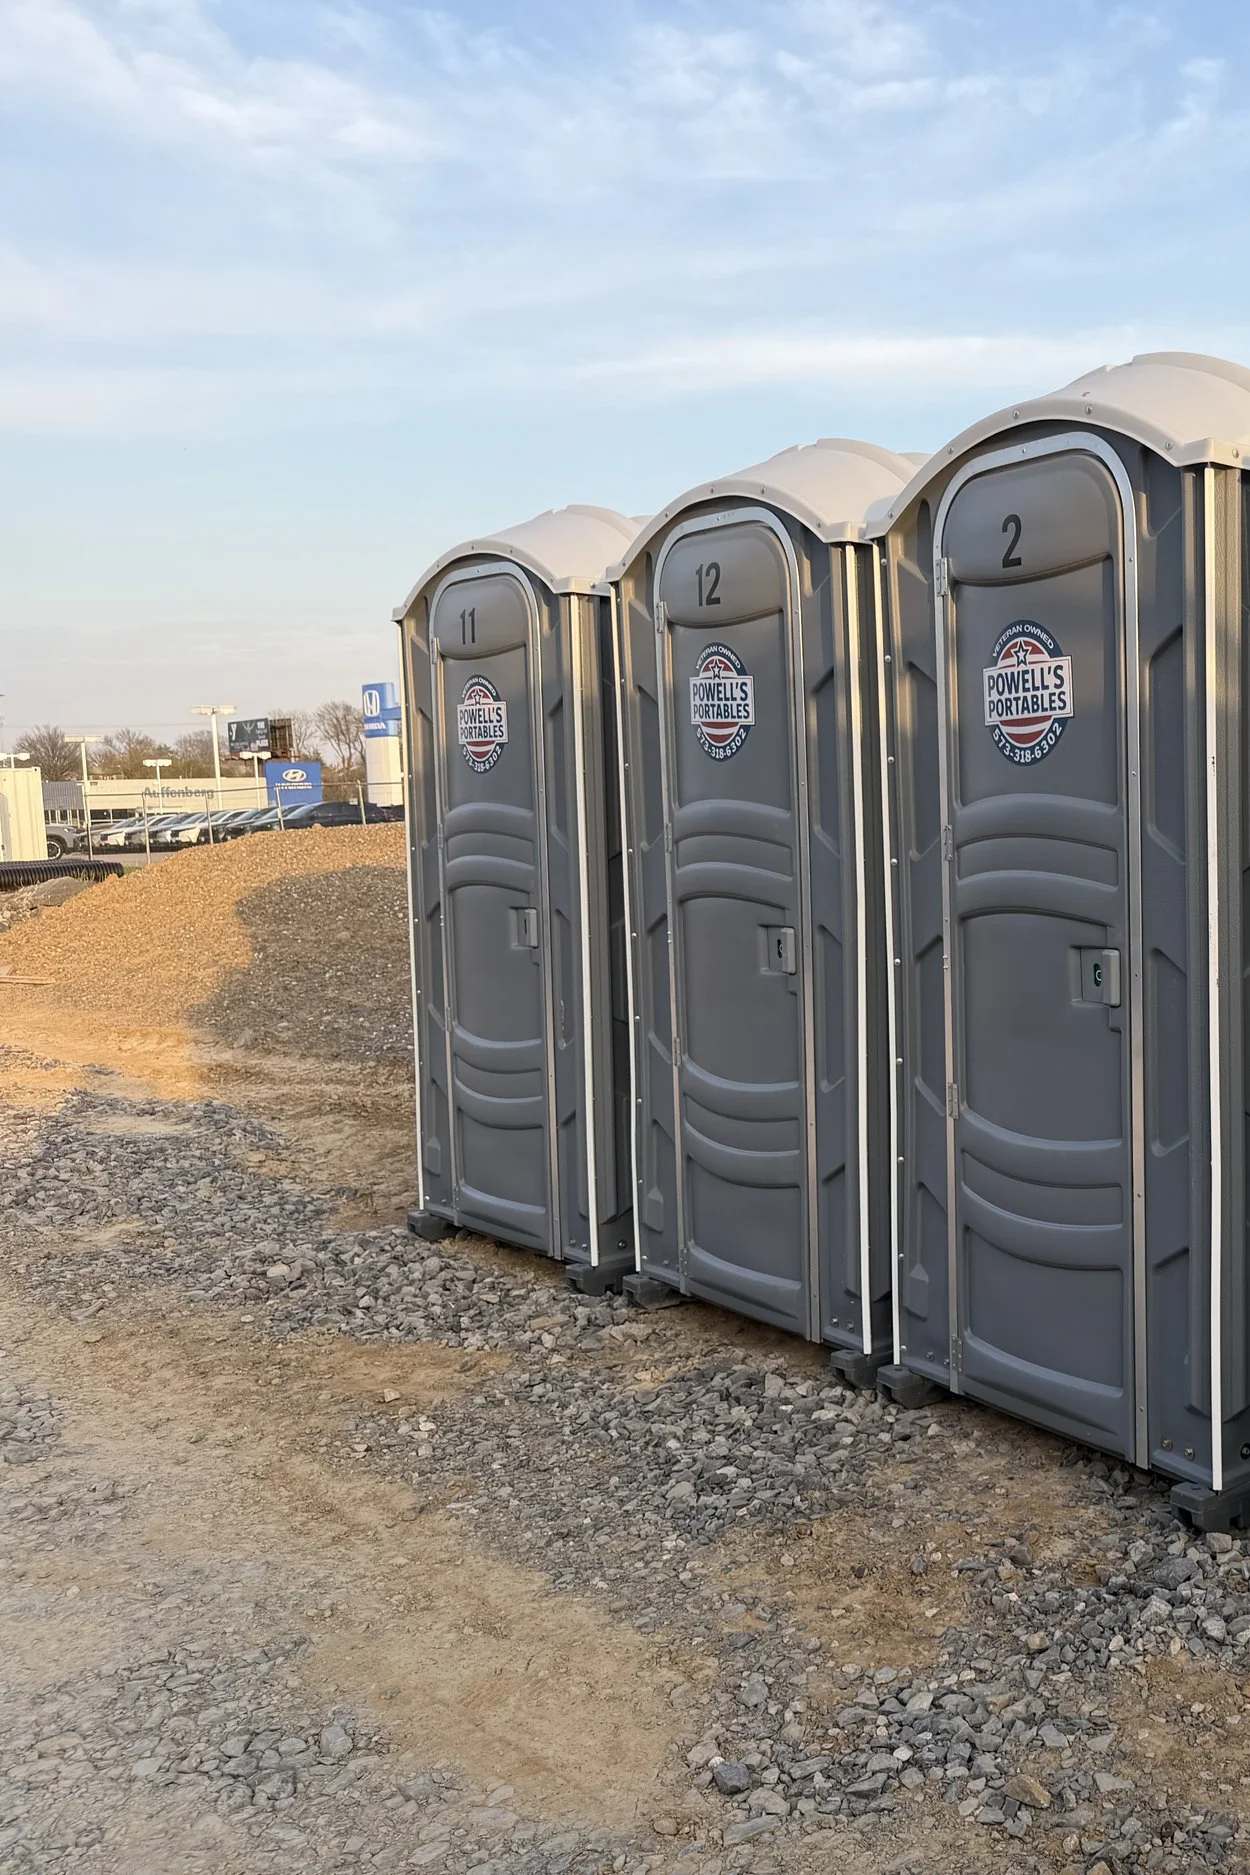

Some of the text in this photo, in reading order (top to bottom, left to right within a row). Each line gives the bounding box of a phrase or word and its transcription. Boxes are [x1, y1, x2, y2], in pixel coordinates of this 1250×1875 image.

[1002, 514, 1022, 568] 2
[695, 562, 721, 607] 12
[460, 607, 475, 645] 11
[992, 625, 1054, 657] VETERAN OWNED
[693, 681, 748, 702] POWELL'S
[987, 664, 1065, 698] POWELL'S
[460, 706, 502, 725] POWELL'S
[693, 703, 750, 720] PORTABLES
[989, 691, 1067, 718] PORTABLES
[460, 724, 504, 740] PORTABLES
[992, 722, 1062, 763] 573-318-6302
[144, 786, 214, 799] Auffenberg
